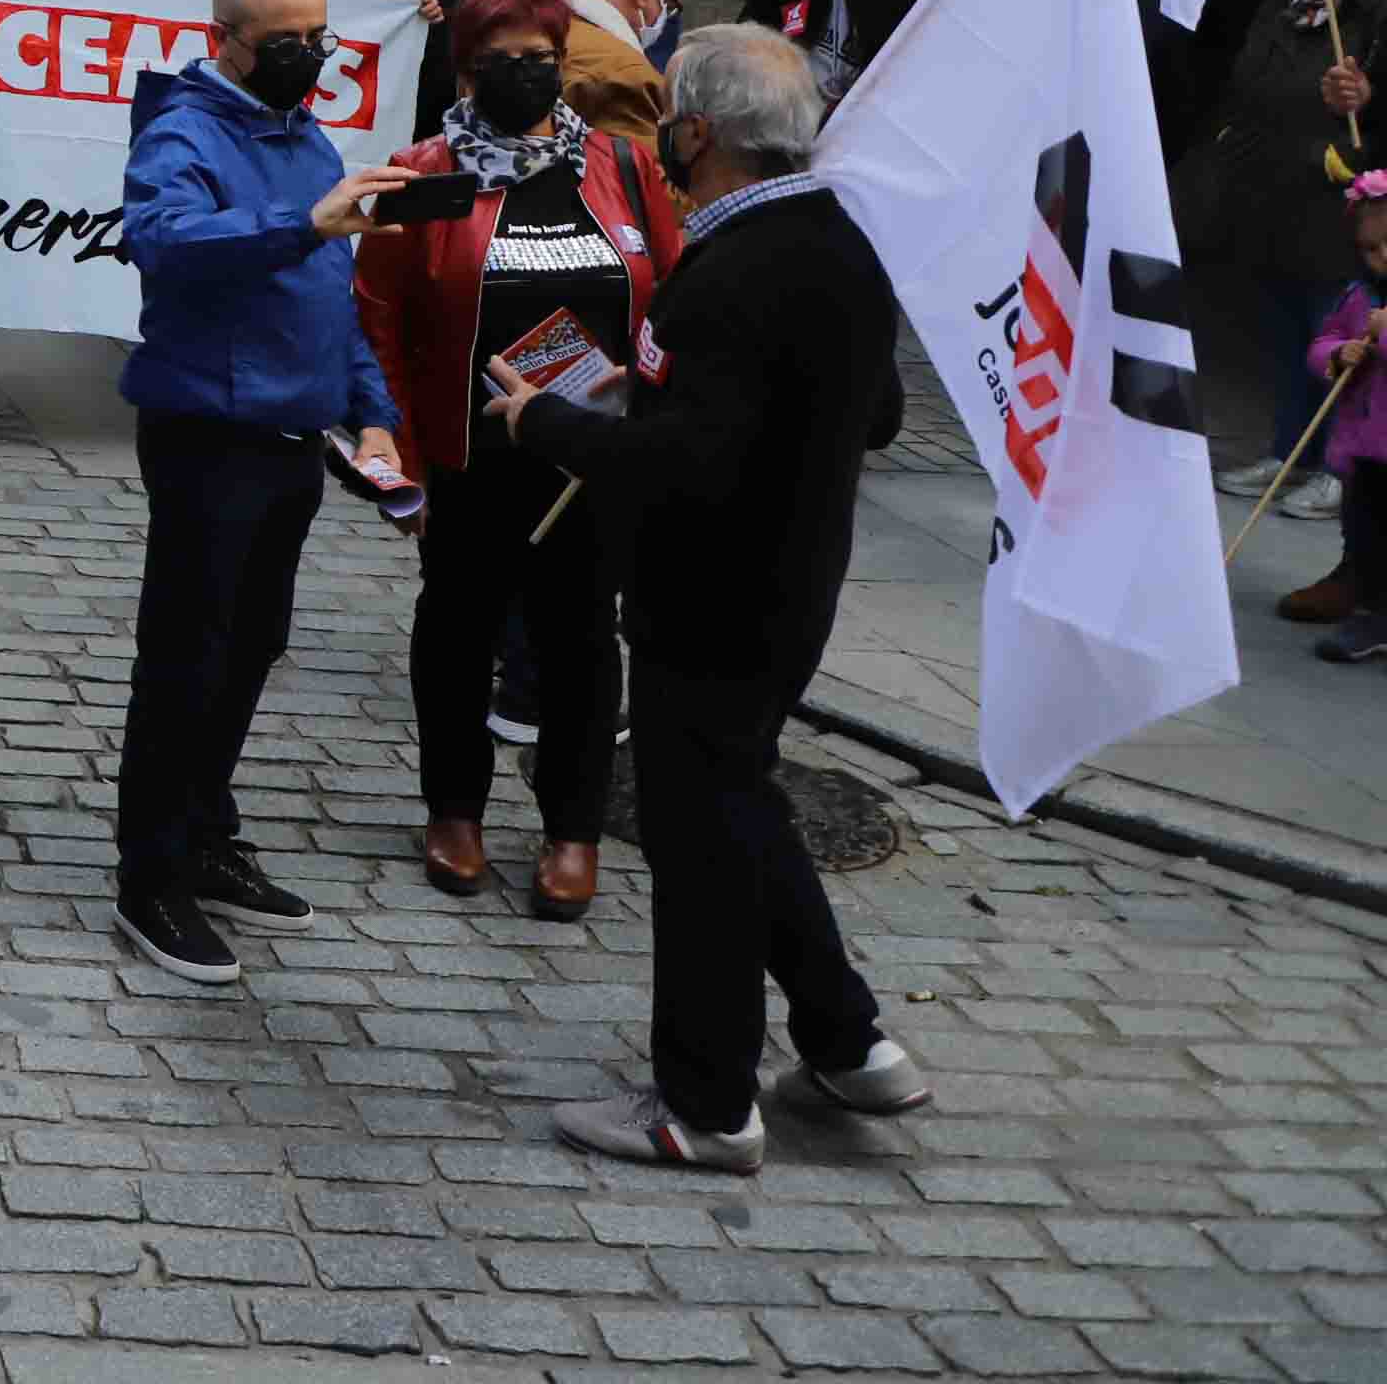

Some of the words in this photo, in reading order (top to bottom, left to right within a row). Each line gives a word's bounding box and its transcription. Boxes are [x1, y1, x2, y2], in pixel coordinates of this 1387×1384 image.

[508, 223, 528, 234] just
[529, 224, 542, 233] be
[543, 223, 577, 233] happy
[546, 342, 588, 361] Obrero
